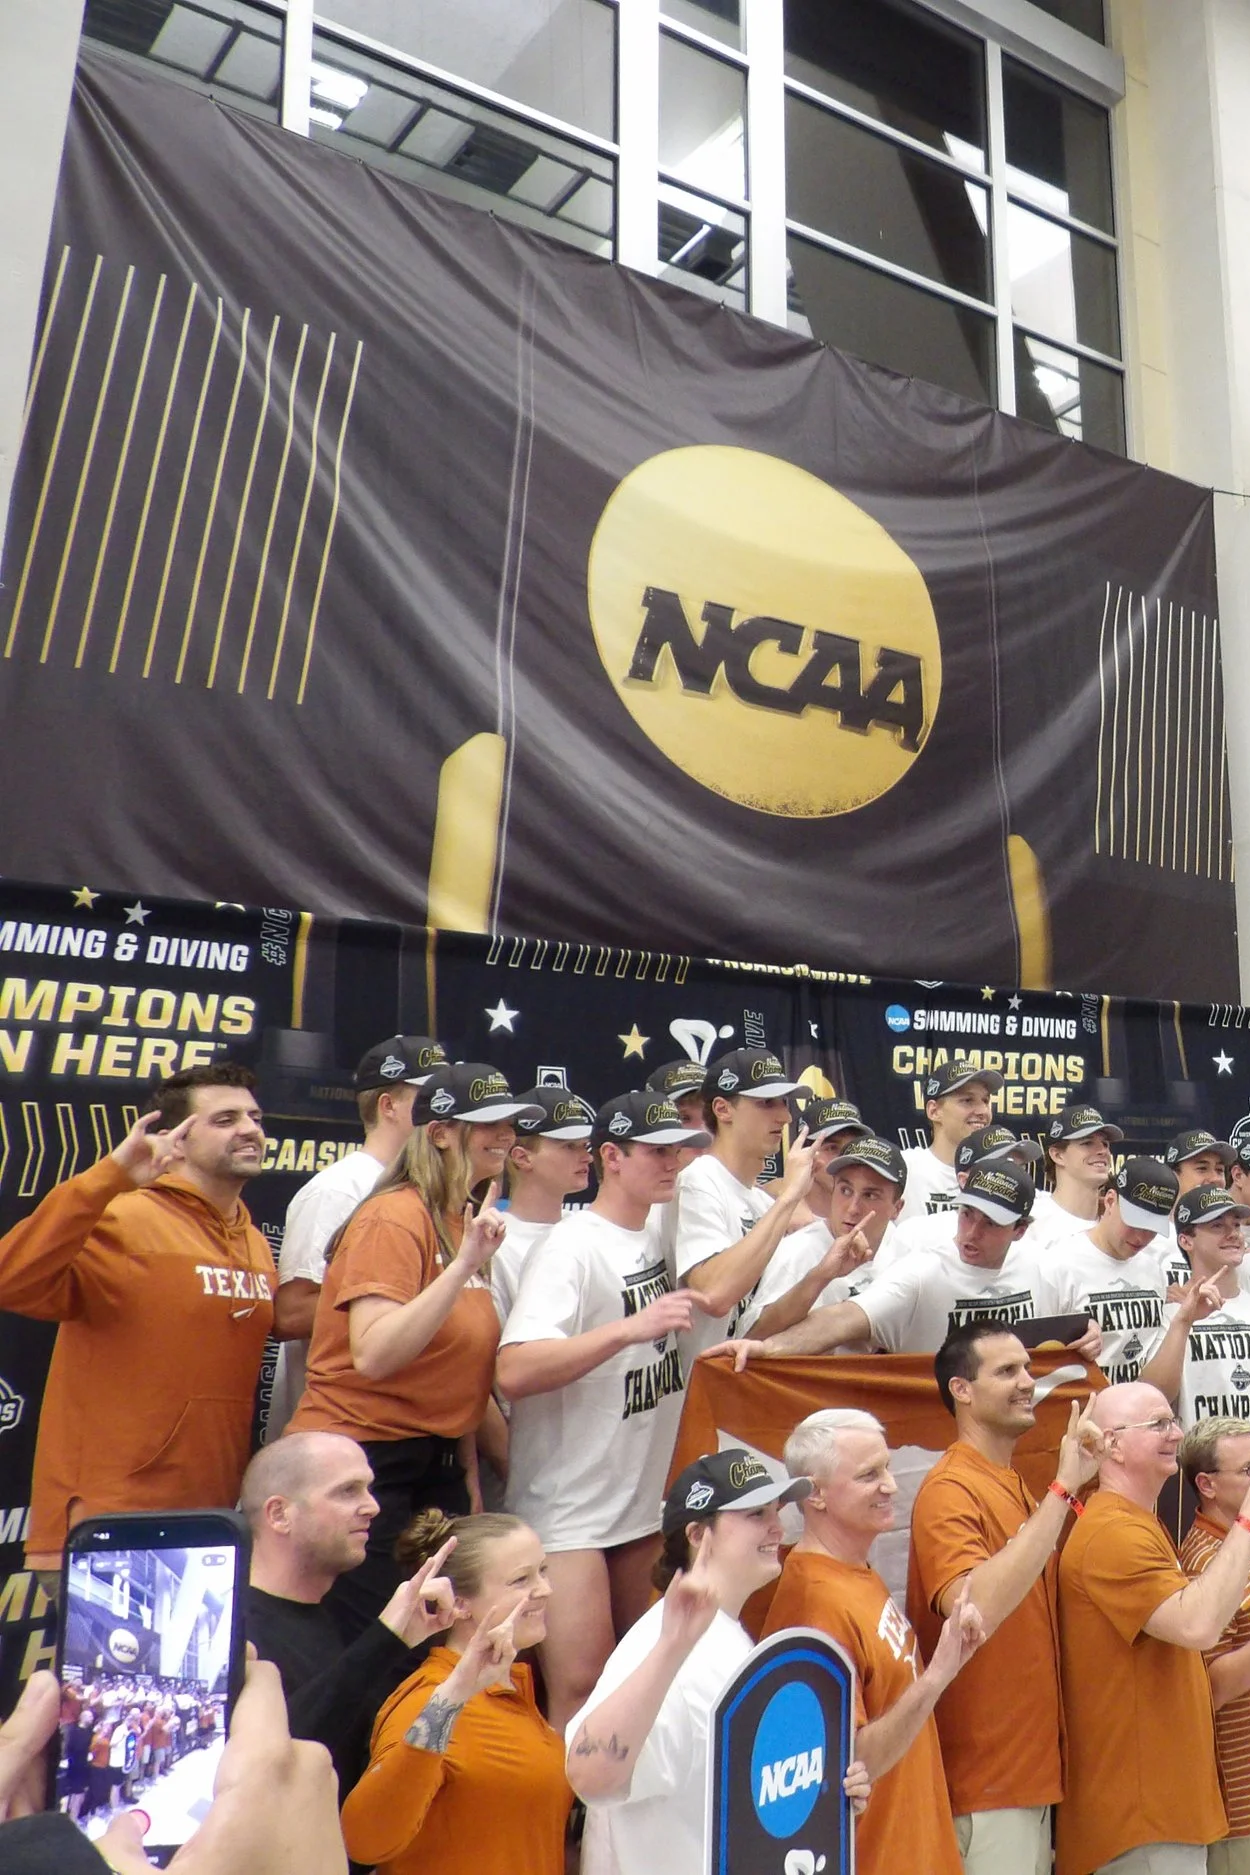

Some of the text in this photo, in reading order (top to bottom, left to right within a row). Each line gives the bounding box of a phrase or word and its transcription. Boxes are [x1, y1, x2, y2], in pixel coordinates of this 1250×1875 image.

[624, 585, 928, 754] NCAA
[113, 932, 139, 962] &
[145, 936, 250, 973] DIVING
[1005, 1015, 1018, 1037] &
[1021, 1016, 1078, 1040] DIVING
[758, 1745, 823, 1808] NCAA
